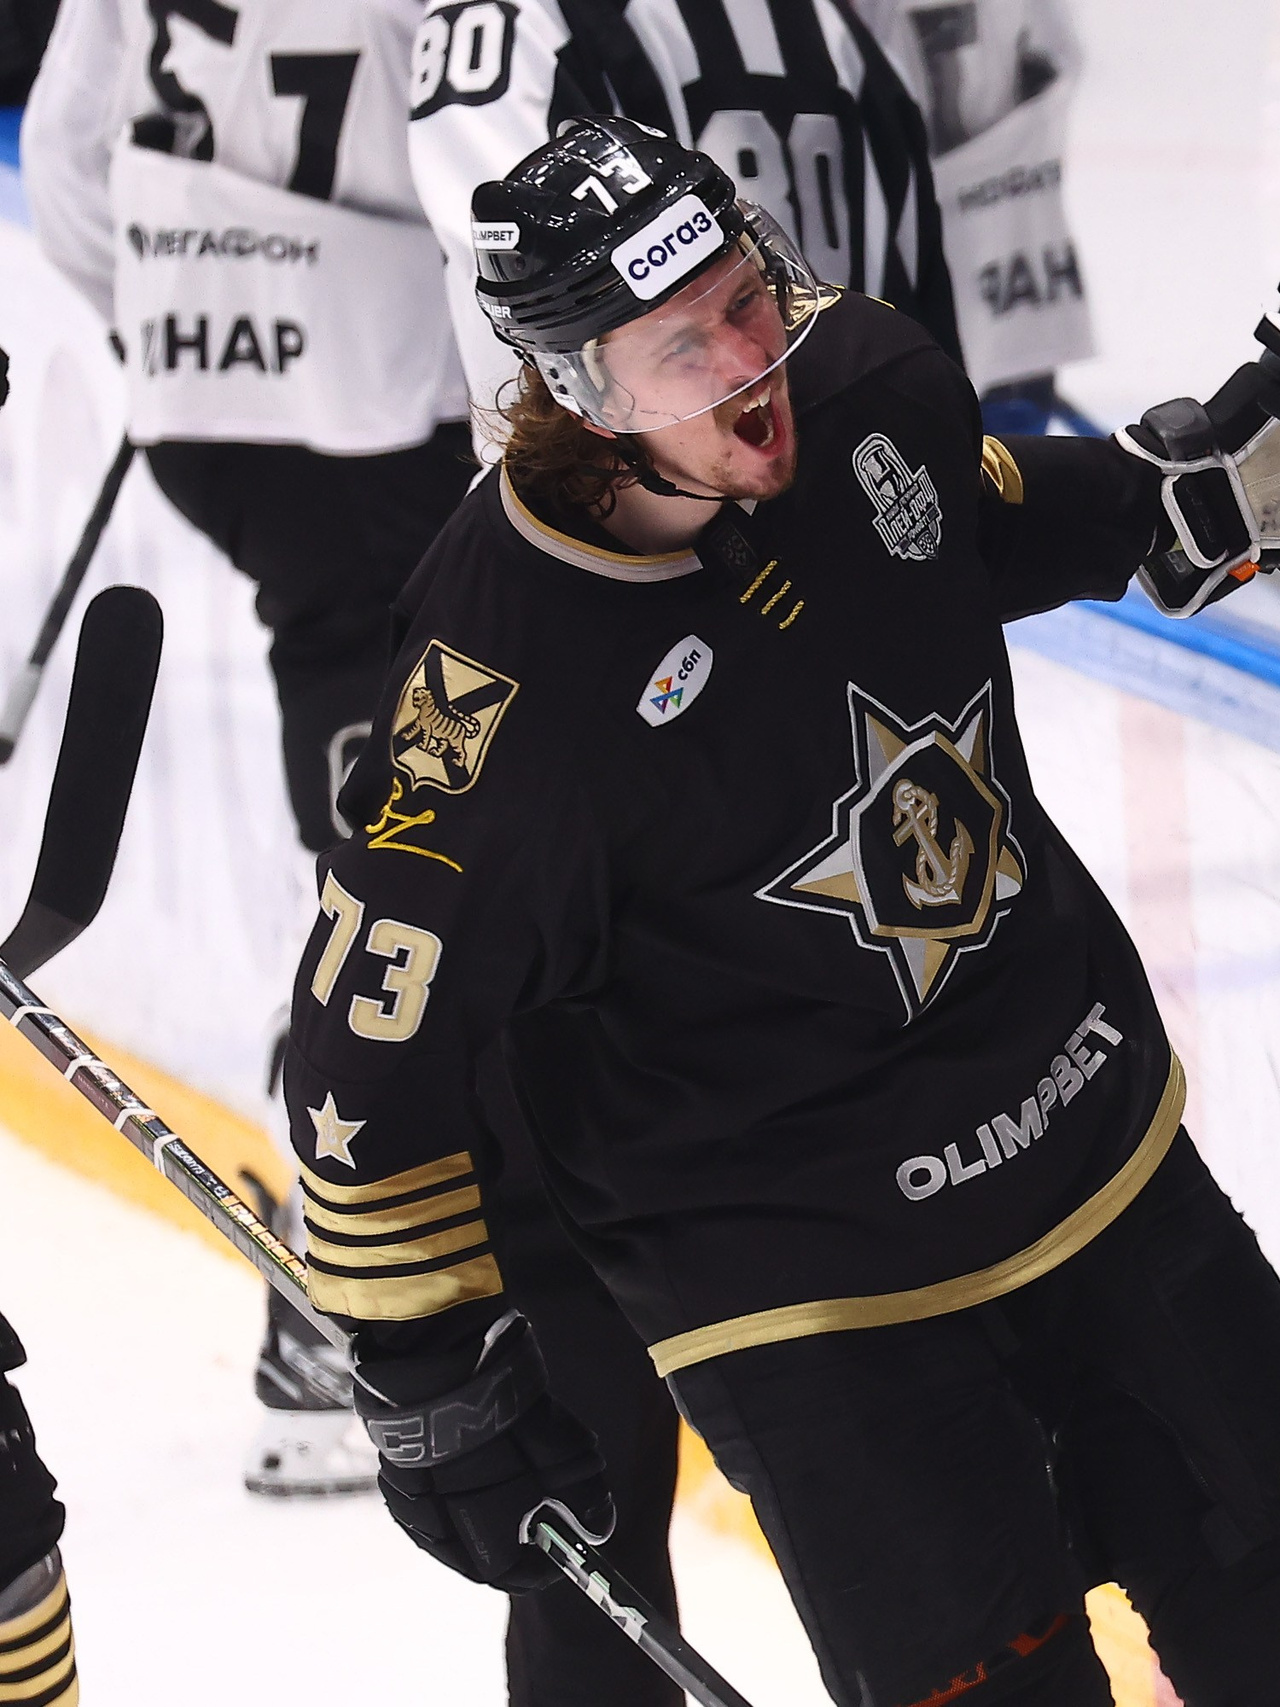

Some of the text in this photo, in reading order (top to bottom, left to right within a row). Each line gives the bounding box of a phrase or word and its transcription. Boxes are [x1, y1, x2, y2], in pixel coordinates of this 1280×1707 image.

[410, 0, 511, 114] 80
[570, 145, 654, 217] 73
[696, 108, 850, 290] 80
[627, 211, 713, 282] согаз
[677, 649, 702, 682] сбп
[309, 867, 444, 1043] 73
[895, 1001, 1124, 1202] OLIMPBET
